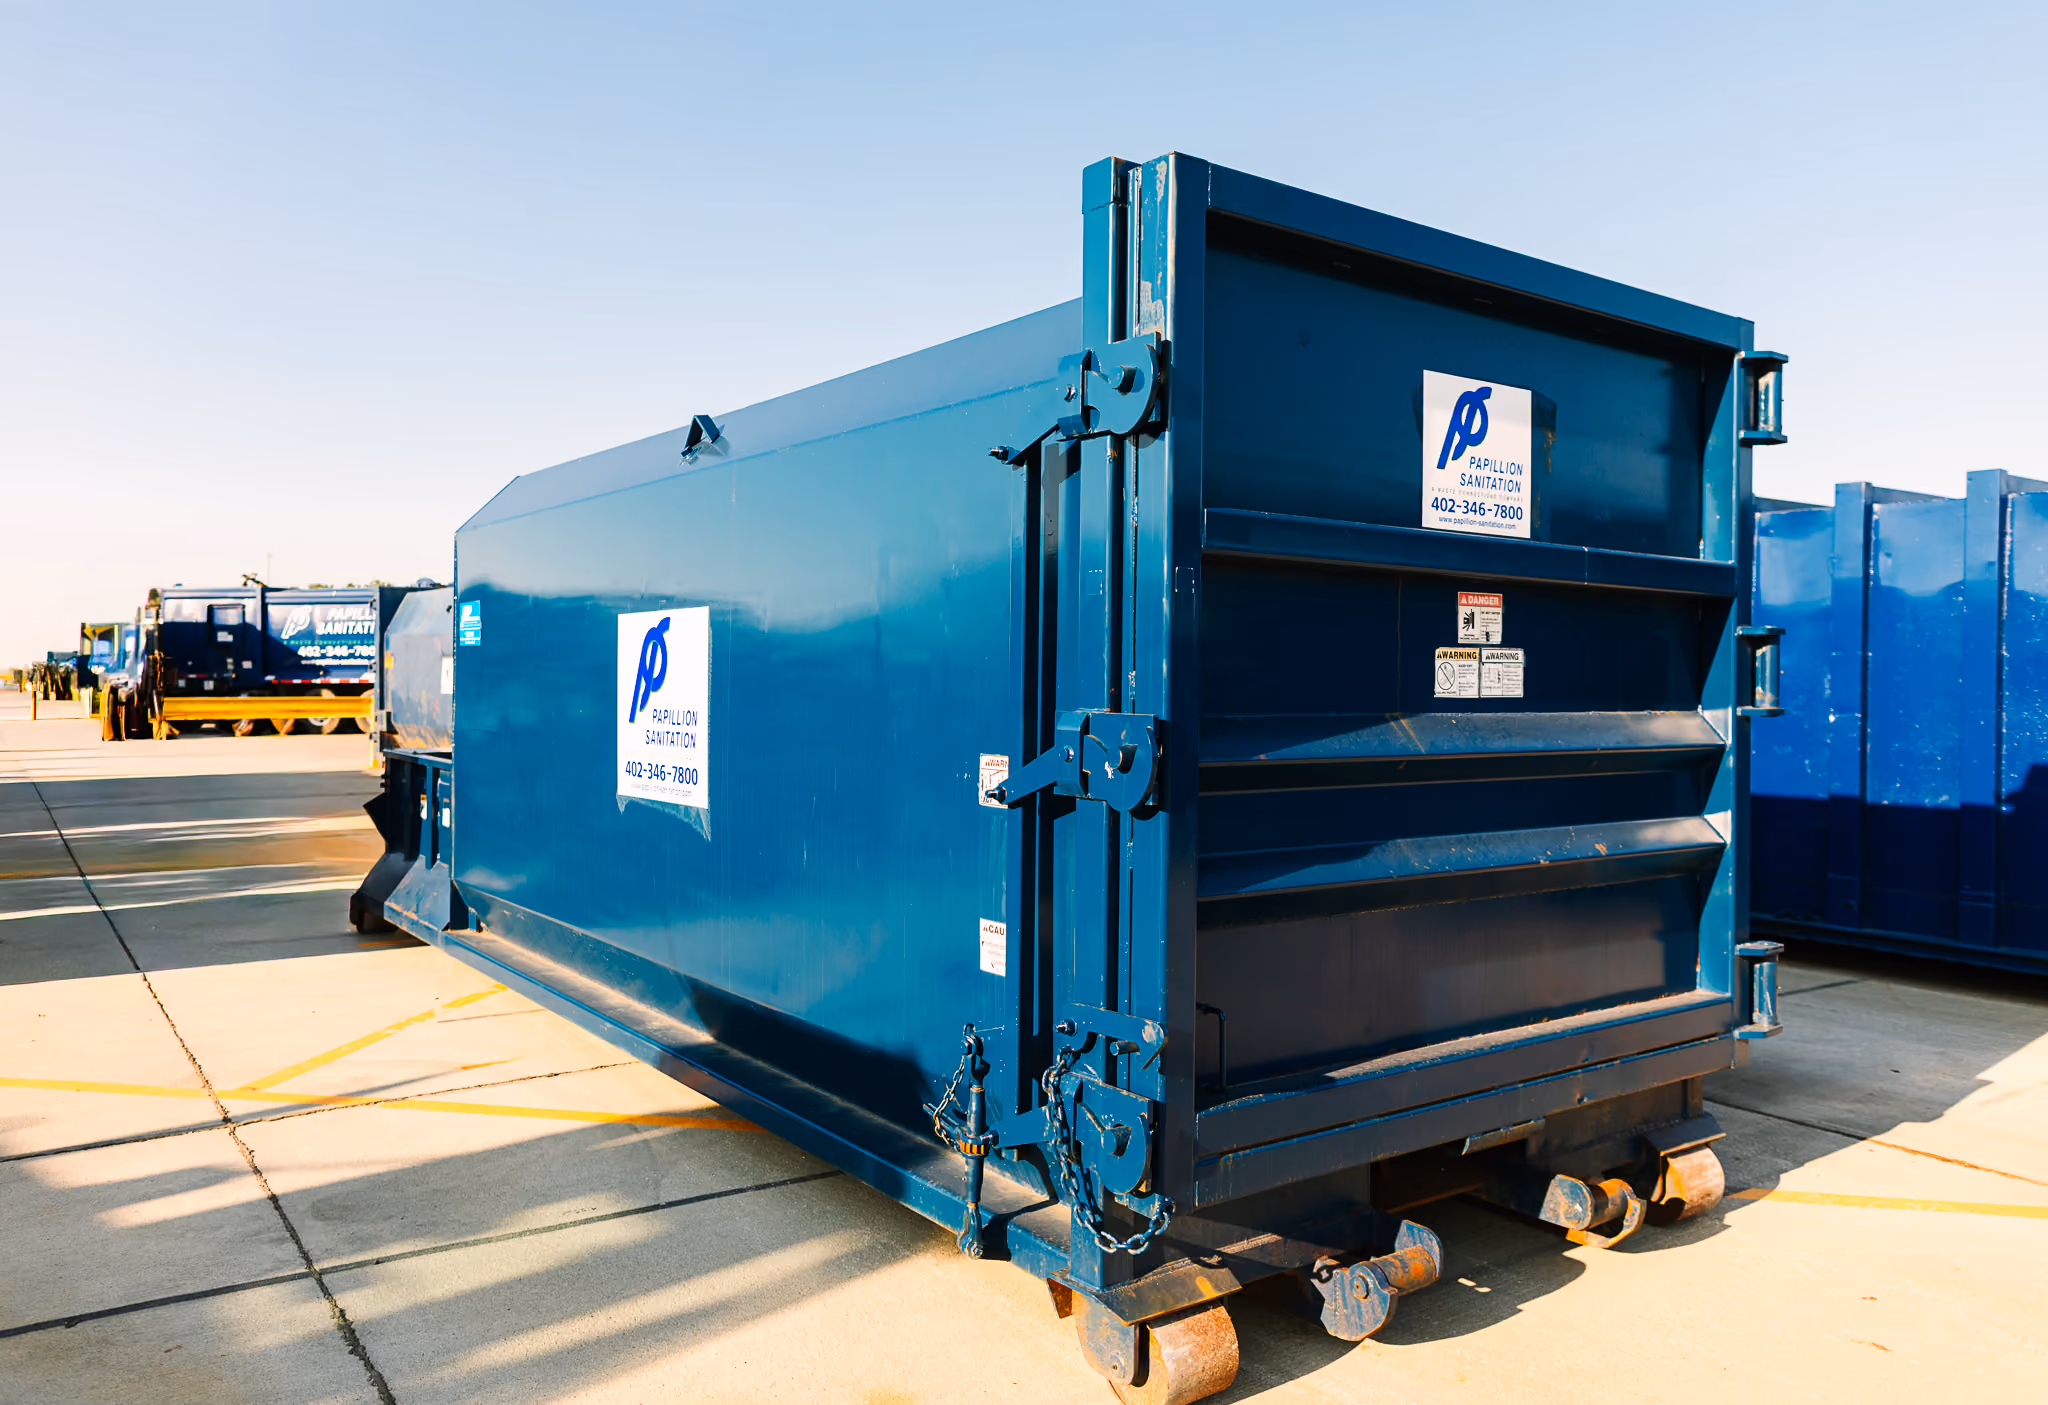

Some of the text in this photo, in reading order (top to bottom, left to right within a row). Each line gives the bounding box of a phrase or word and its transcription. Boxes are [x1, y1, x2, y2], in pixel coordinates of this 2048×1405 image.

[1469, 456, 1523, 476] PAPILLION
[1460, 473, 1521, 493] SANITATION
[1431, 497, 1523, 520] 402-346-7800
[1468, 595, 1499, 606] DANGER
[1441, 651, 1477, 660] WARNING
[1490, 652, 1519, 660] WARNING
[652, 709, 698, 727] PAPILLION
[645, 730, 697, 749] SANITATION
[625, 761, 698, 785] 402-346-7800
